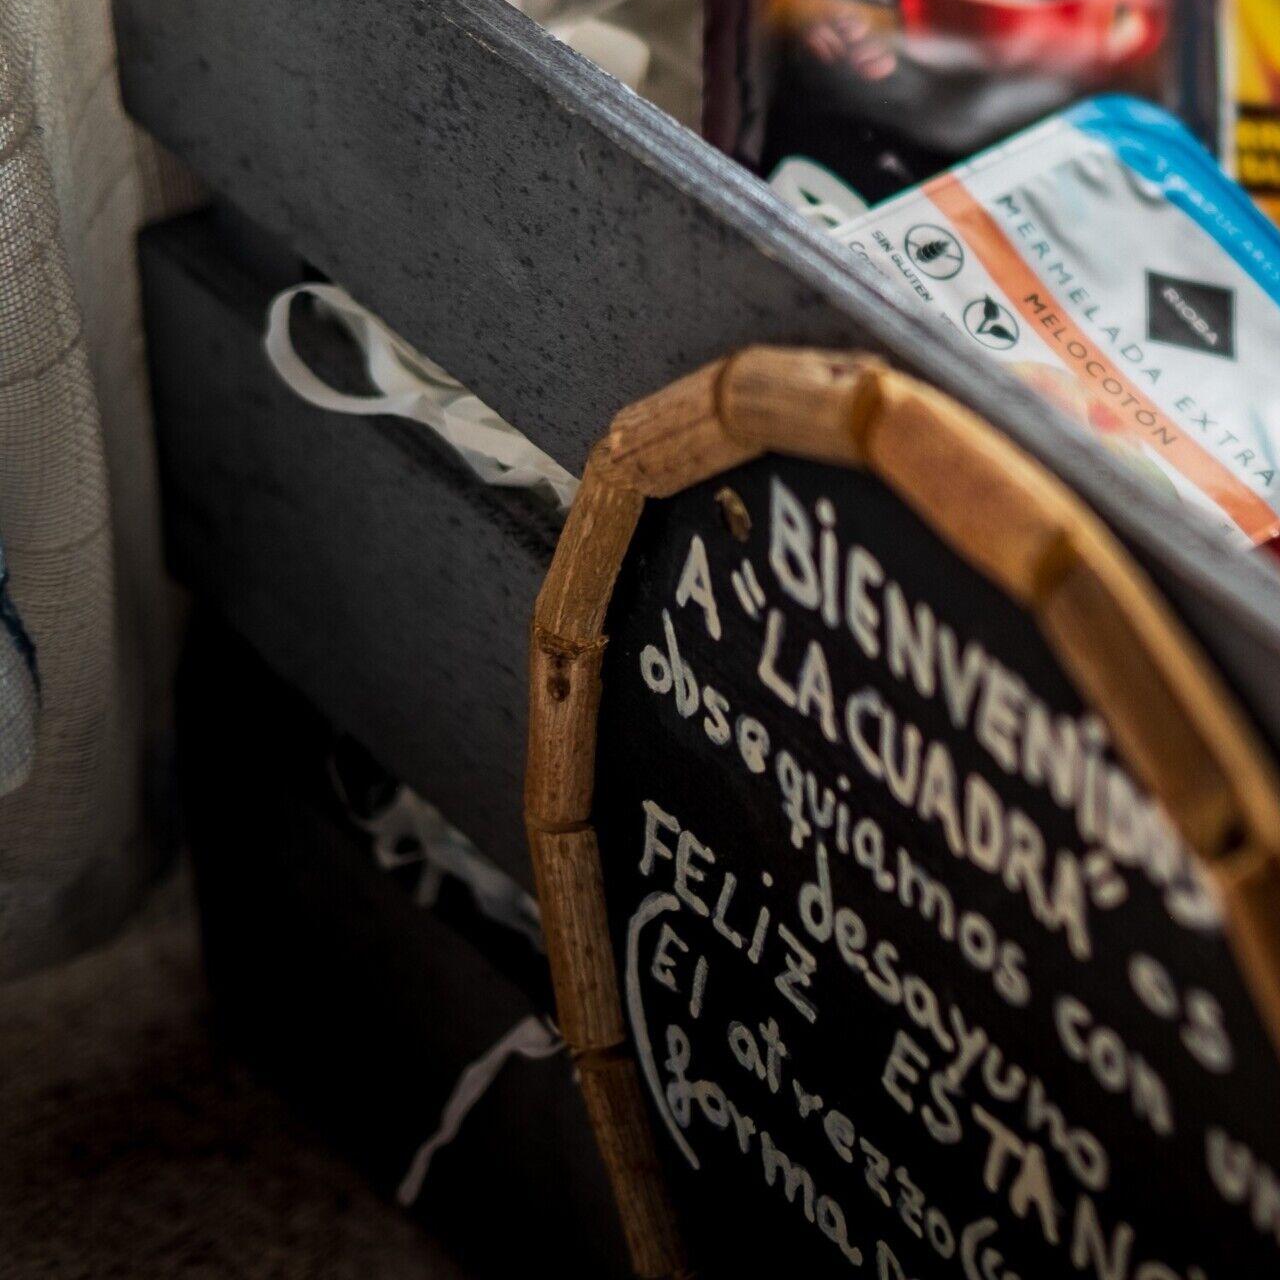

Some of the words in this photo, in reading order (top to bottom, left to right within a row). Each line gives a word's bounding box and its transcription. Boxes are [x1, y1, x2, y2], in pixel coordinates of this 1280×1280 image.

[871, 229, 895, 253] SIN
[890, 253, 934, 303] GLUTEN
[1162, 287, 1219, 346] RIOBA
[995, 194, 1163, 387] MERMELADA
[1173, 395, 1279, 489] EXTRA
[1024, 292, 1177, 448] MELOCOTÓN
[675, 533, 722, 642] A
[799, 838, 1109, 1192] desayuno
[1054, 995, 1174, 1135] con
